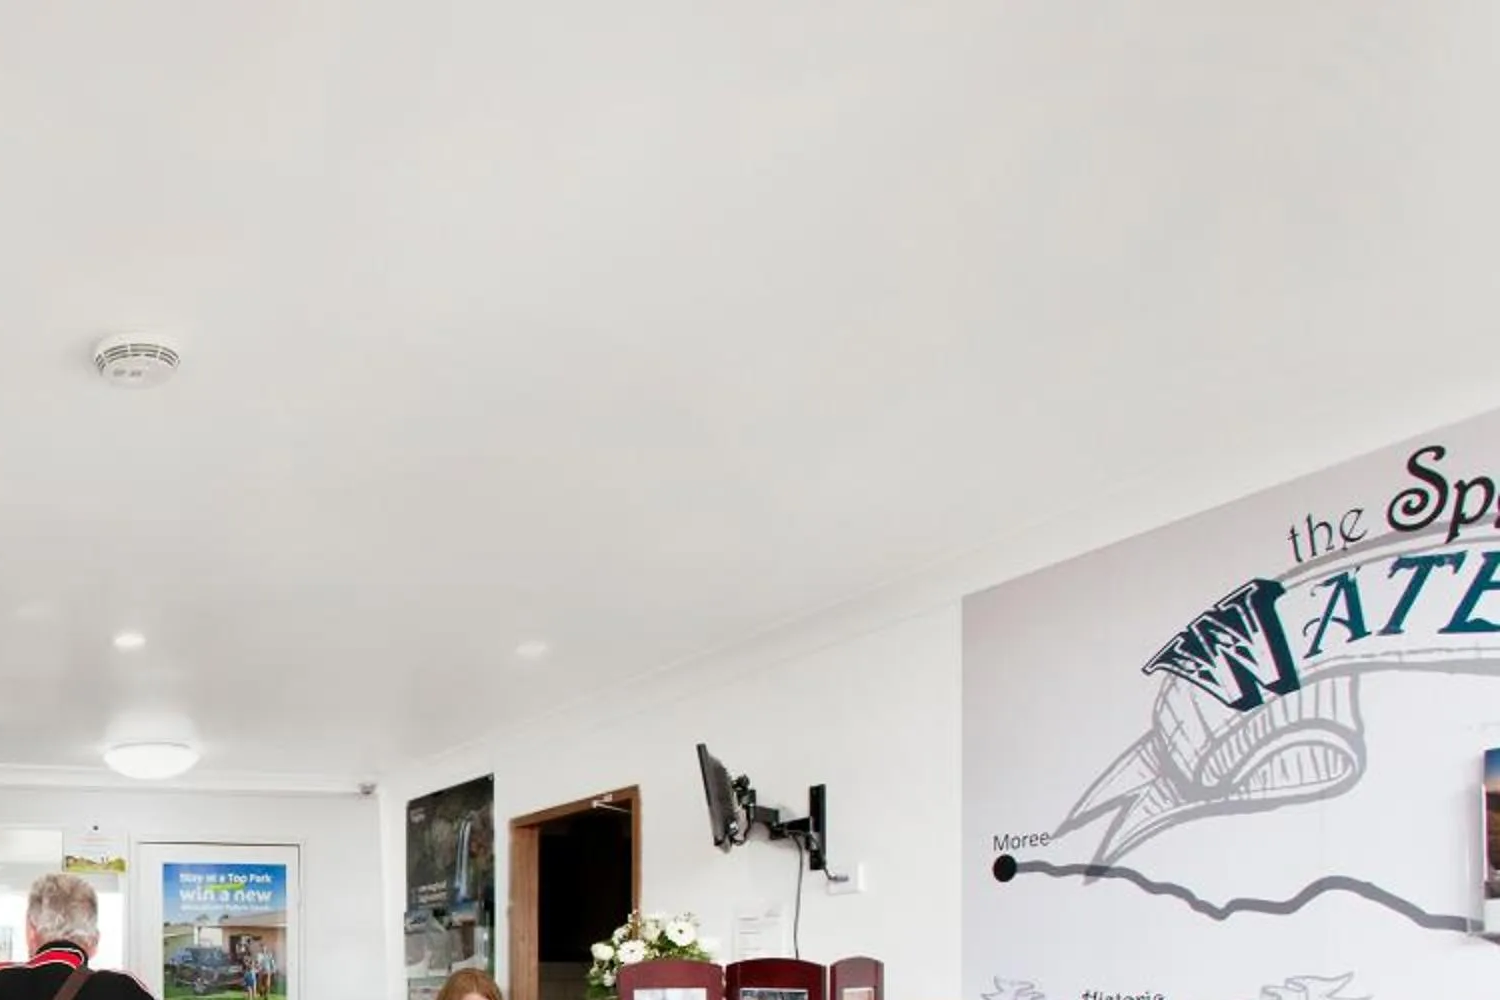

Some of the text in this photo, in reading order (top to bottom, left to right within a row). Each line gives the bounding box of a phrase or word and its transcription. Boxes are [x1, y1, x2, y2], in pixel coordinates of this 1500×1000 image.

[1287, 445, 1500, 563] the Sp
[993, 830, 1051, 852] Moree
[179, 886, 272, 902] win a new
